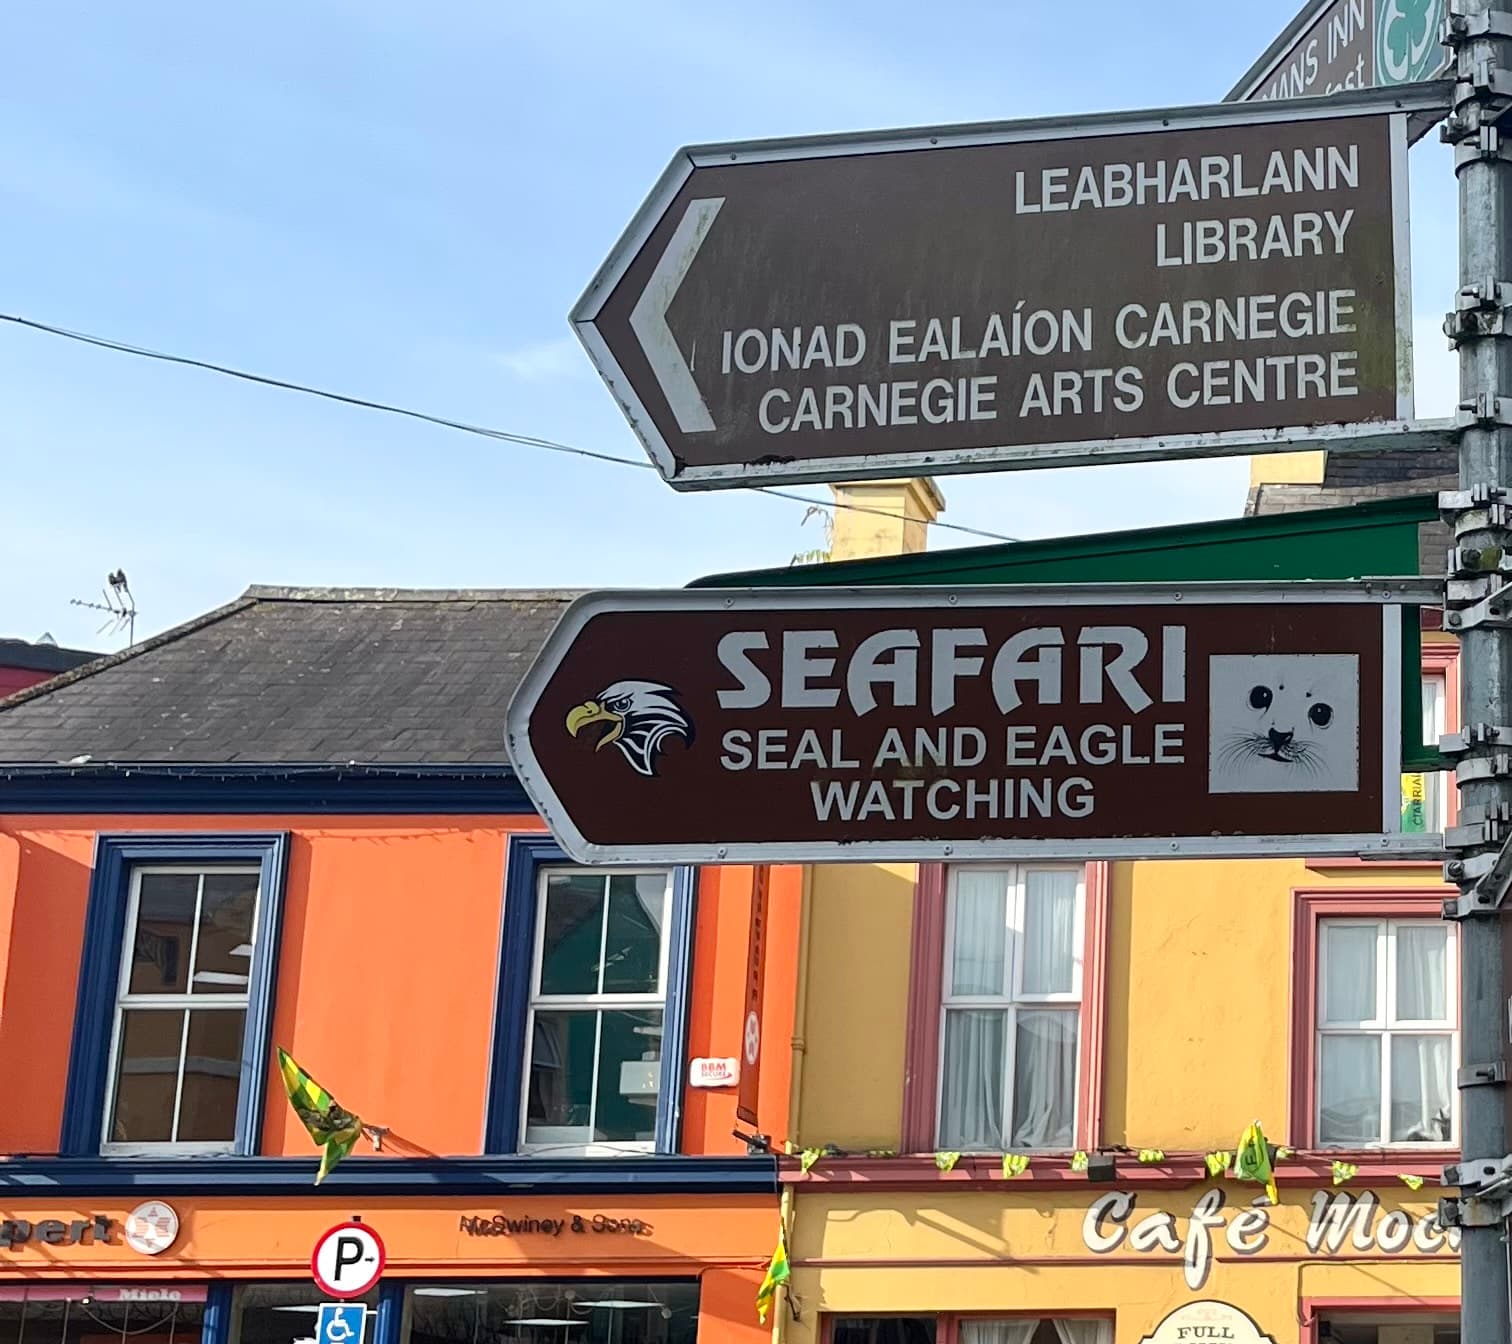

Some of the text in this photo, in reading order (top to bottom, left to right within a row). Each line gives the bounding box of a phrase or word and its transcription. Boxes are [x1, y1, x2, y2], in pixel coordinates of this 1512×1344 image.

[1015, 144, 1359, 216] LEABHARLANN
[1155, 209, 1355, 268] LIBRARY
[721, 288, 1358, 374] IONAD EALAÍON CARNEGIE
[757, 350, 1359, 434] CARNEGIE ARTS CENTRE
[715, 624, 1187, 717] SEAFARI
[719, 722, 1186, 771] SEAL AND EAGLE
[808, 776, 1096, 823] WATCHING
[571, 1214, 586, 1234] &
[1081, 1187, 1462, 1290] Café Moc
[333, 1236, 365, 1281] P
[119, 1288, 181, 1301] Miele
[1177, 1325, 1235, 1340] FULL
